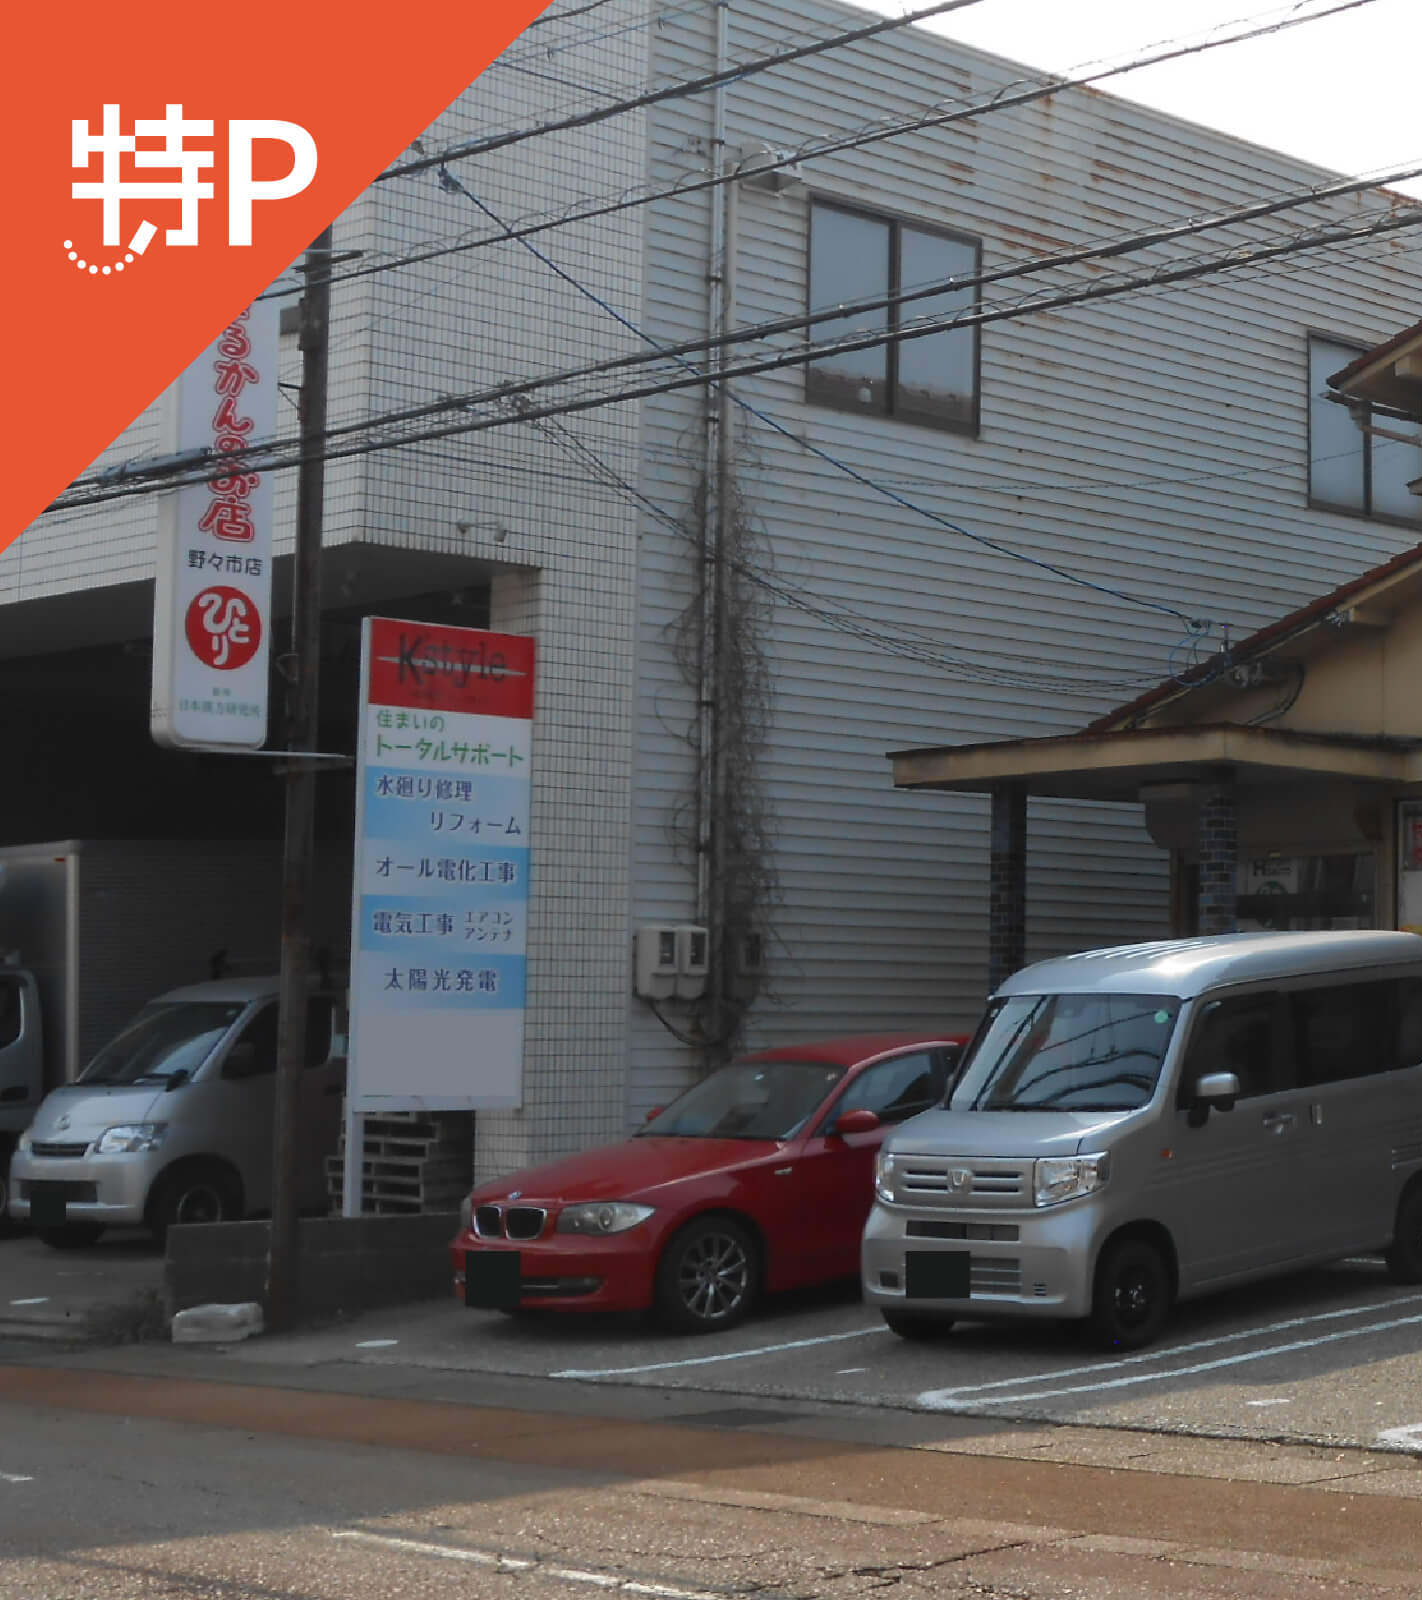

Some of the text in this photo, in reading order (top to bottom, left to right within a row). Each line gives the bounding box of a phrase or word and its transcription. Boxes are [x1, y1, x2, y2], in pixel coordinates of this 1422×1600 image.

[200, 304, 259, 541] るかんのお店
[187, 550, 264, 576] 野々市店
[376, 710, 445, 733] 住まいの
[376, 733, 525, 768] トータルサポート
[376, 774, 474, 802] 水廻り修理
[430, 810, 522, 835] リフォーム
[375, 856, 516, 883] オール電化工事
[372, 911, 456, 936] 電気工事
[384, 967, 498, 993] 太陽光発電
